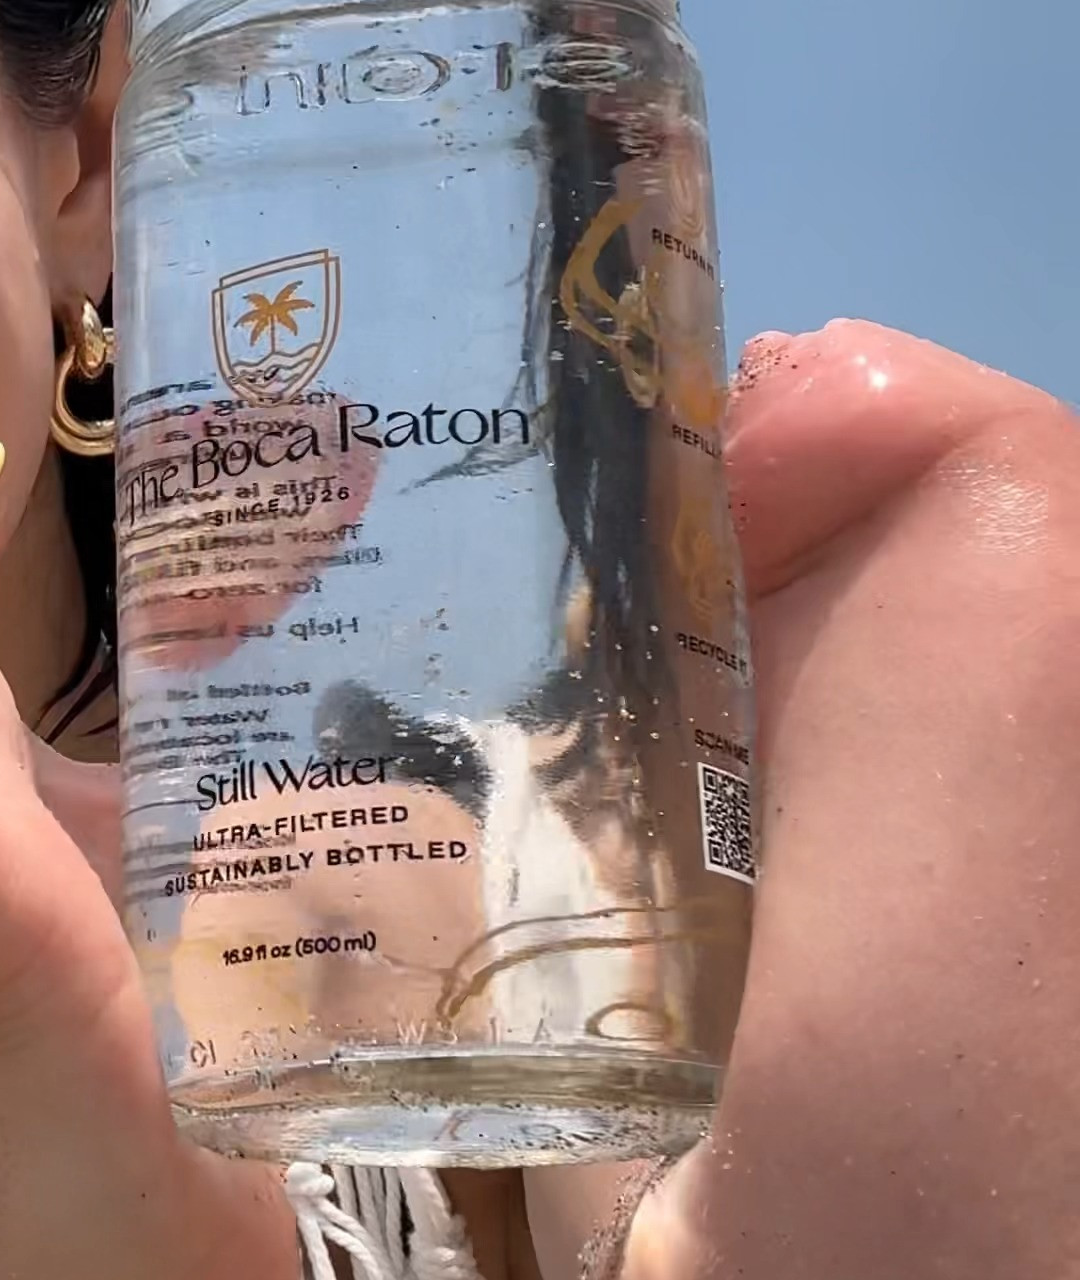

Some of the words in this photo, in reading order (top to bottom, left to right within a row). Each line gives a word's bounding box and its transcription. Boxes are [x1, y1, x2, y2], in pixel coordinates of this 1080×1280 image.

[651, 227, 706, 272] RETURN
[122, 461, 179, 524] The
[191, 421, 321, 489] Boca
[337, 402, 529, 453] Raton
[214, 498, 279, 527] SINCE
[293, 486, 350, 509] 1926
[676, 632, 738, 671] RECYCLE
[694, 728, 732, 756] SCAN
[196, 761, 258, 811] Still
[262, 754, 404, 796] Water
[192, 805, 410, 852] ULTRA-FILTERED
[164, 851, 314, 897] SUSTAINABLY
[326, 839, 468, 866] BOTTLED
[222, 946, 254, 966] 16.9
[270, 944, 292, 959] oz
[294, 935, 341, 957] (500
[344, 930, 377, 952] ml)
